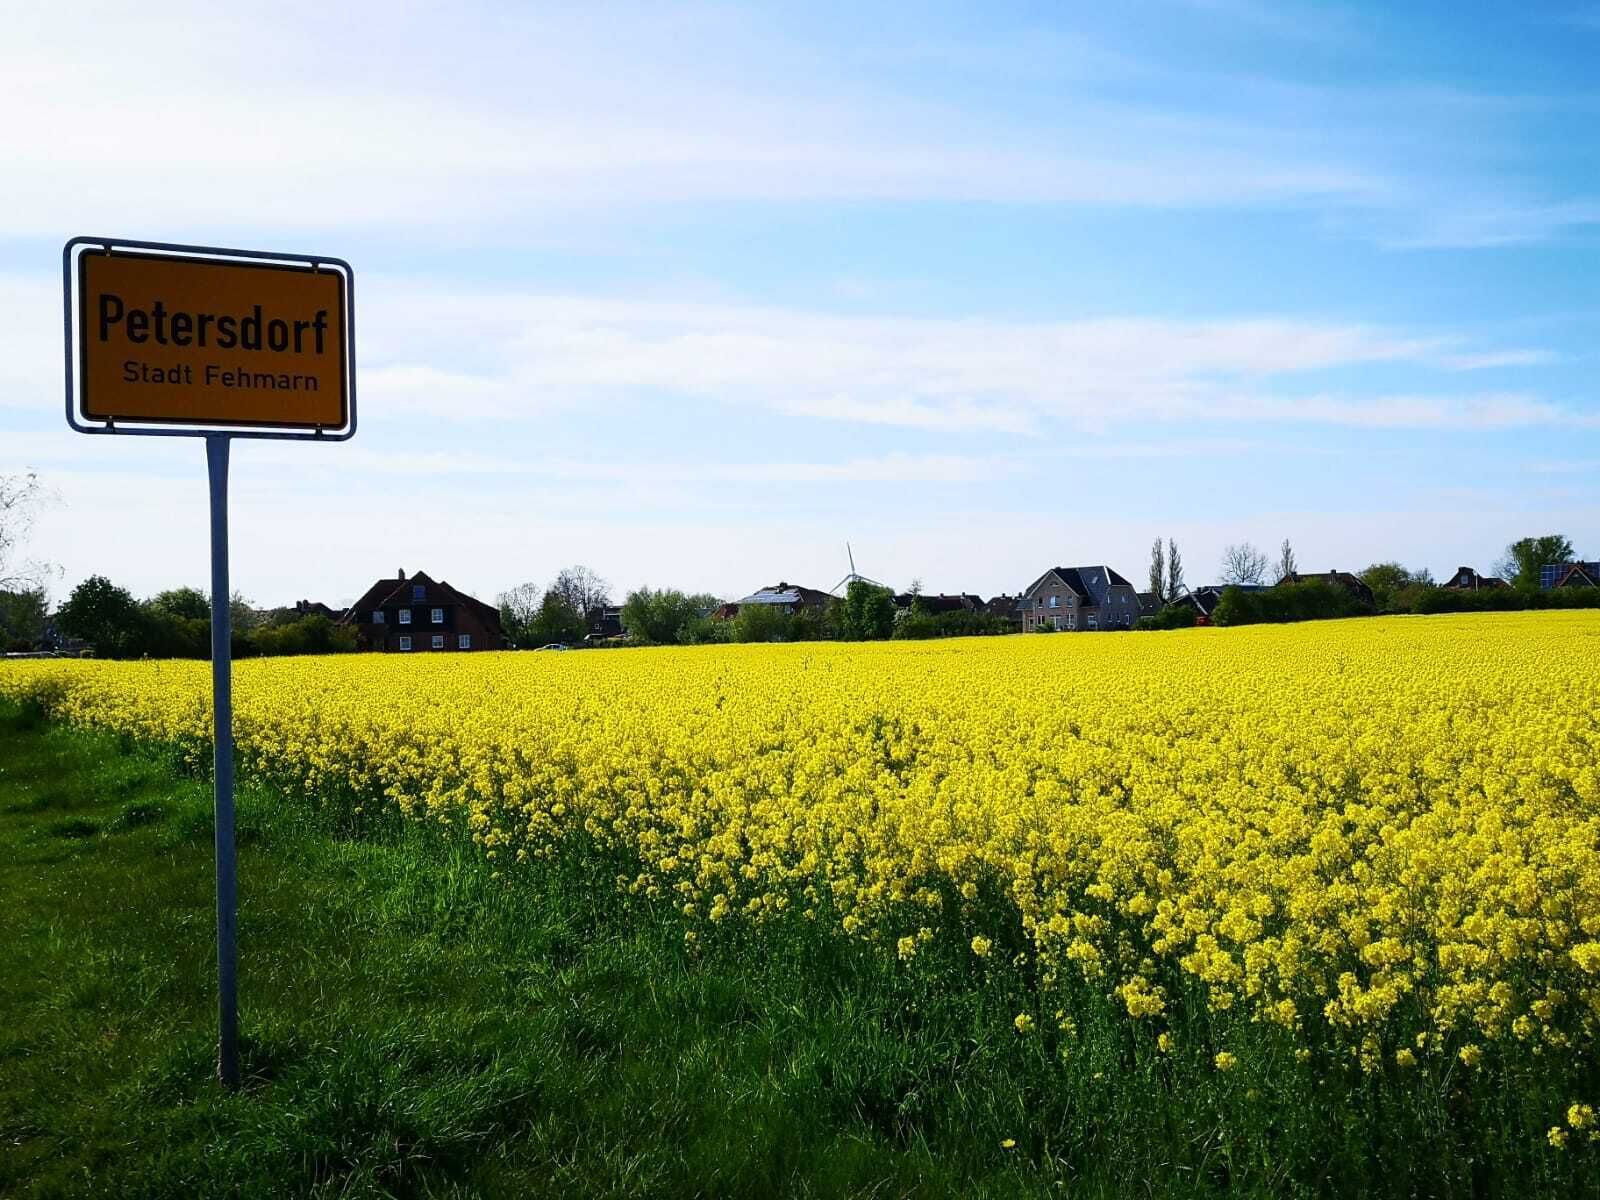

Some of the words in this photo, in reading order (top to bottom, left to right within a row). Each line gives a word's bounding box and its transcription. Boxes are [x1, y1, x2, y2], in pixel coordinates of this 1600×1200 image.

[99, 294, 328, 354] Petersdorf
[123, 361, 193, 385] Stadt
[205, 365, 319, 391] Fehmarn
